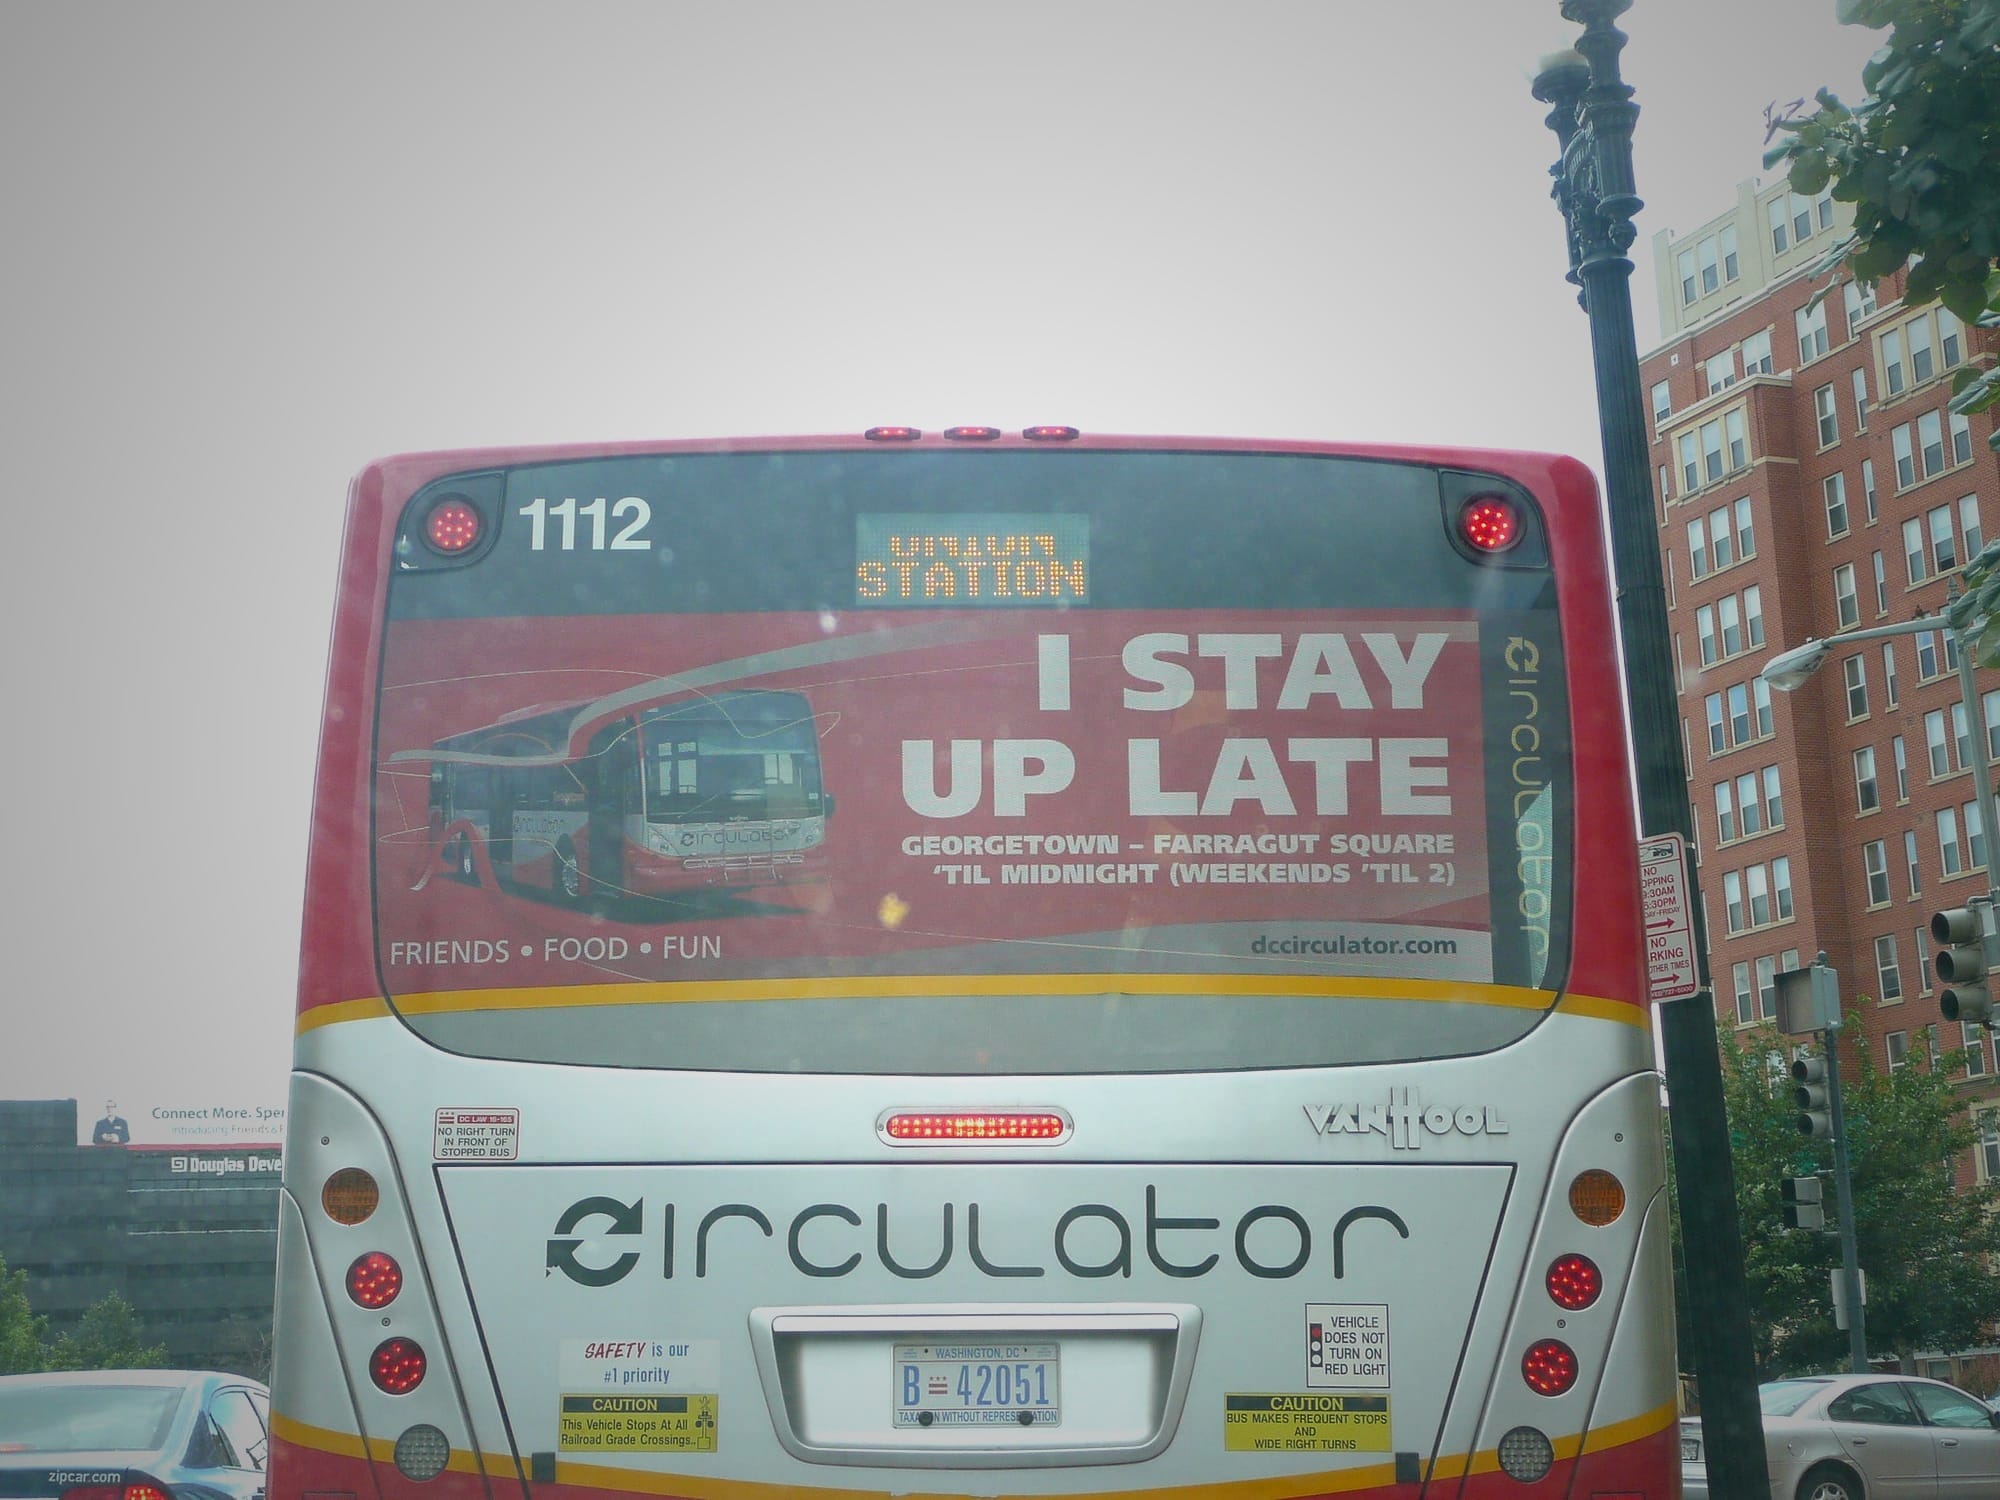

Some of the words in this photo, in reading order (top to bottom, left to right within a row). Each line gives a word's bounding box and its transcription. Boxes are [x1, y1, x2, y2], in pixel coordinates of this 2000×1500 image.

[518, 497, 653, 551] 1112
[857, 560, 1085, 597] STATION
[1037, 634, 1071, 711] I
[1121, 632, 1449, 711] STAY
[902, 739, 1076, 819] UP
[1127, 737, 1453, 817] LATE
[901, 835, 1119, 857] GEORGETOWN
[1153, 834, 1321, 855] FARRAGUT
[1330, 833, 1456, 857] SQUARE
[1001, 863, 1160, 884] MIDNIGHT
[1169, 862, 1352, 887] (WEEKENDS
[1361, 863, 1420, 884] 'TIL
[1428, 862, 1456, 887] 2)
[1643, 866, 1657, 877] NO
[1641, 874, 1675, 889] OPPING
[1643, 905, 1681, 918] DAY-FRIDAY
[1250, 934, 1458, 955] dccirculator.com
[1650, 937, 1667, 949] NO
[389, 940, 510, 965] FRIENDS
[543, 937, 629, 962] FOOD
[662, 935, 722, 960] FUN
[1650, 946, 1684, 962] RKING
[1670, 959, 1690, 970] TIMES
[152, 1107, 208, 1119] Connect
[212, 1107, 252, 1119] More.
[458, 1115, 470, 1123] DC
[438, 1127, 452, 1136] NO
[456, 1127, 486, 1136] RIGHT
[490, 1127, 515, 1136] TURN
[444, 1138, 454, 1146] IN
[458, 1138, 490, 1146] FRONT
[494, 1138, 508, 1146] OF
[441, 1148, 486, 1157] STOPPED
[489, 1148, 510, 1157] BUS
[190, 1156, 245, 1176] Douglas
[1331, 1316, 1379, 1329] VEHICLE
[1324, 1332, 1357, 1344] DOES
[1361, 1332, 1386, 1344] NOT
[584, 1342, 646, 1359] SAFETY
[652, 1341, 663, 1357] is
[668, 1344, 690, 1357] our
[1006, 1347, 1020, 1358] DC
[1329, 1348, 1360, 1360] TURN
[1365, 1348, 1382, 1360] ON
[604, 1368, 617, 1383] #1
[623, 1367, 670, 1385] priority
[1325, 1364, 1348, 1375] RED
[1353, 1364, 1386, 1375] LIGHT
[903, 1365, 920, 1406] B
[956, 1364, 1050, 1406] 42051
[592, 1399, 658, 1412] CAUTION
[1270, 1397, 1344, 1411] CAUTION
[899, 1411, 940, 1423] TAXAN
[941, 1411, 981, 1422] WITHOUT
[1226, 1413, 1248, 1424] BUS
[1252, 1413, 1289, 1424] MAKES
[1293, 1414, 1349, 1424] FREQUENT
[1353, 1414, 1388, 1424] STOPS
[562, 1419, 582, 1430] This
[586, 1419, 622, 1430] Vehicle
[626, 1419, 656, 1432] Stops
[660, 1419, 671, 1430] At
[675, 1419, 688, 1430] All
[1294, 1427, 1316, 1437] AND
[561, 1434, 601, 1445] Railroad
[606, 1434, 636, 1445] Grade
[1254, 1439, 1281, 1449] WIDE
[1285, 1439, 1317, 1449] RIGHT
[1321, 1439, 1356, 1449] TURNS
[48, 1468, 121, 1485] zipcar.com
